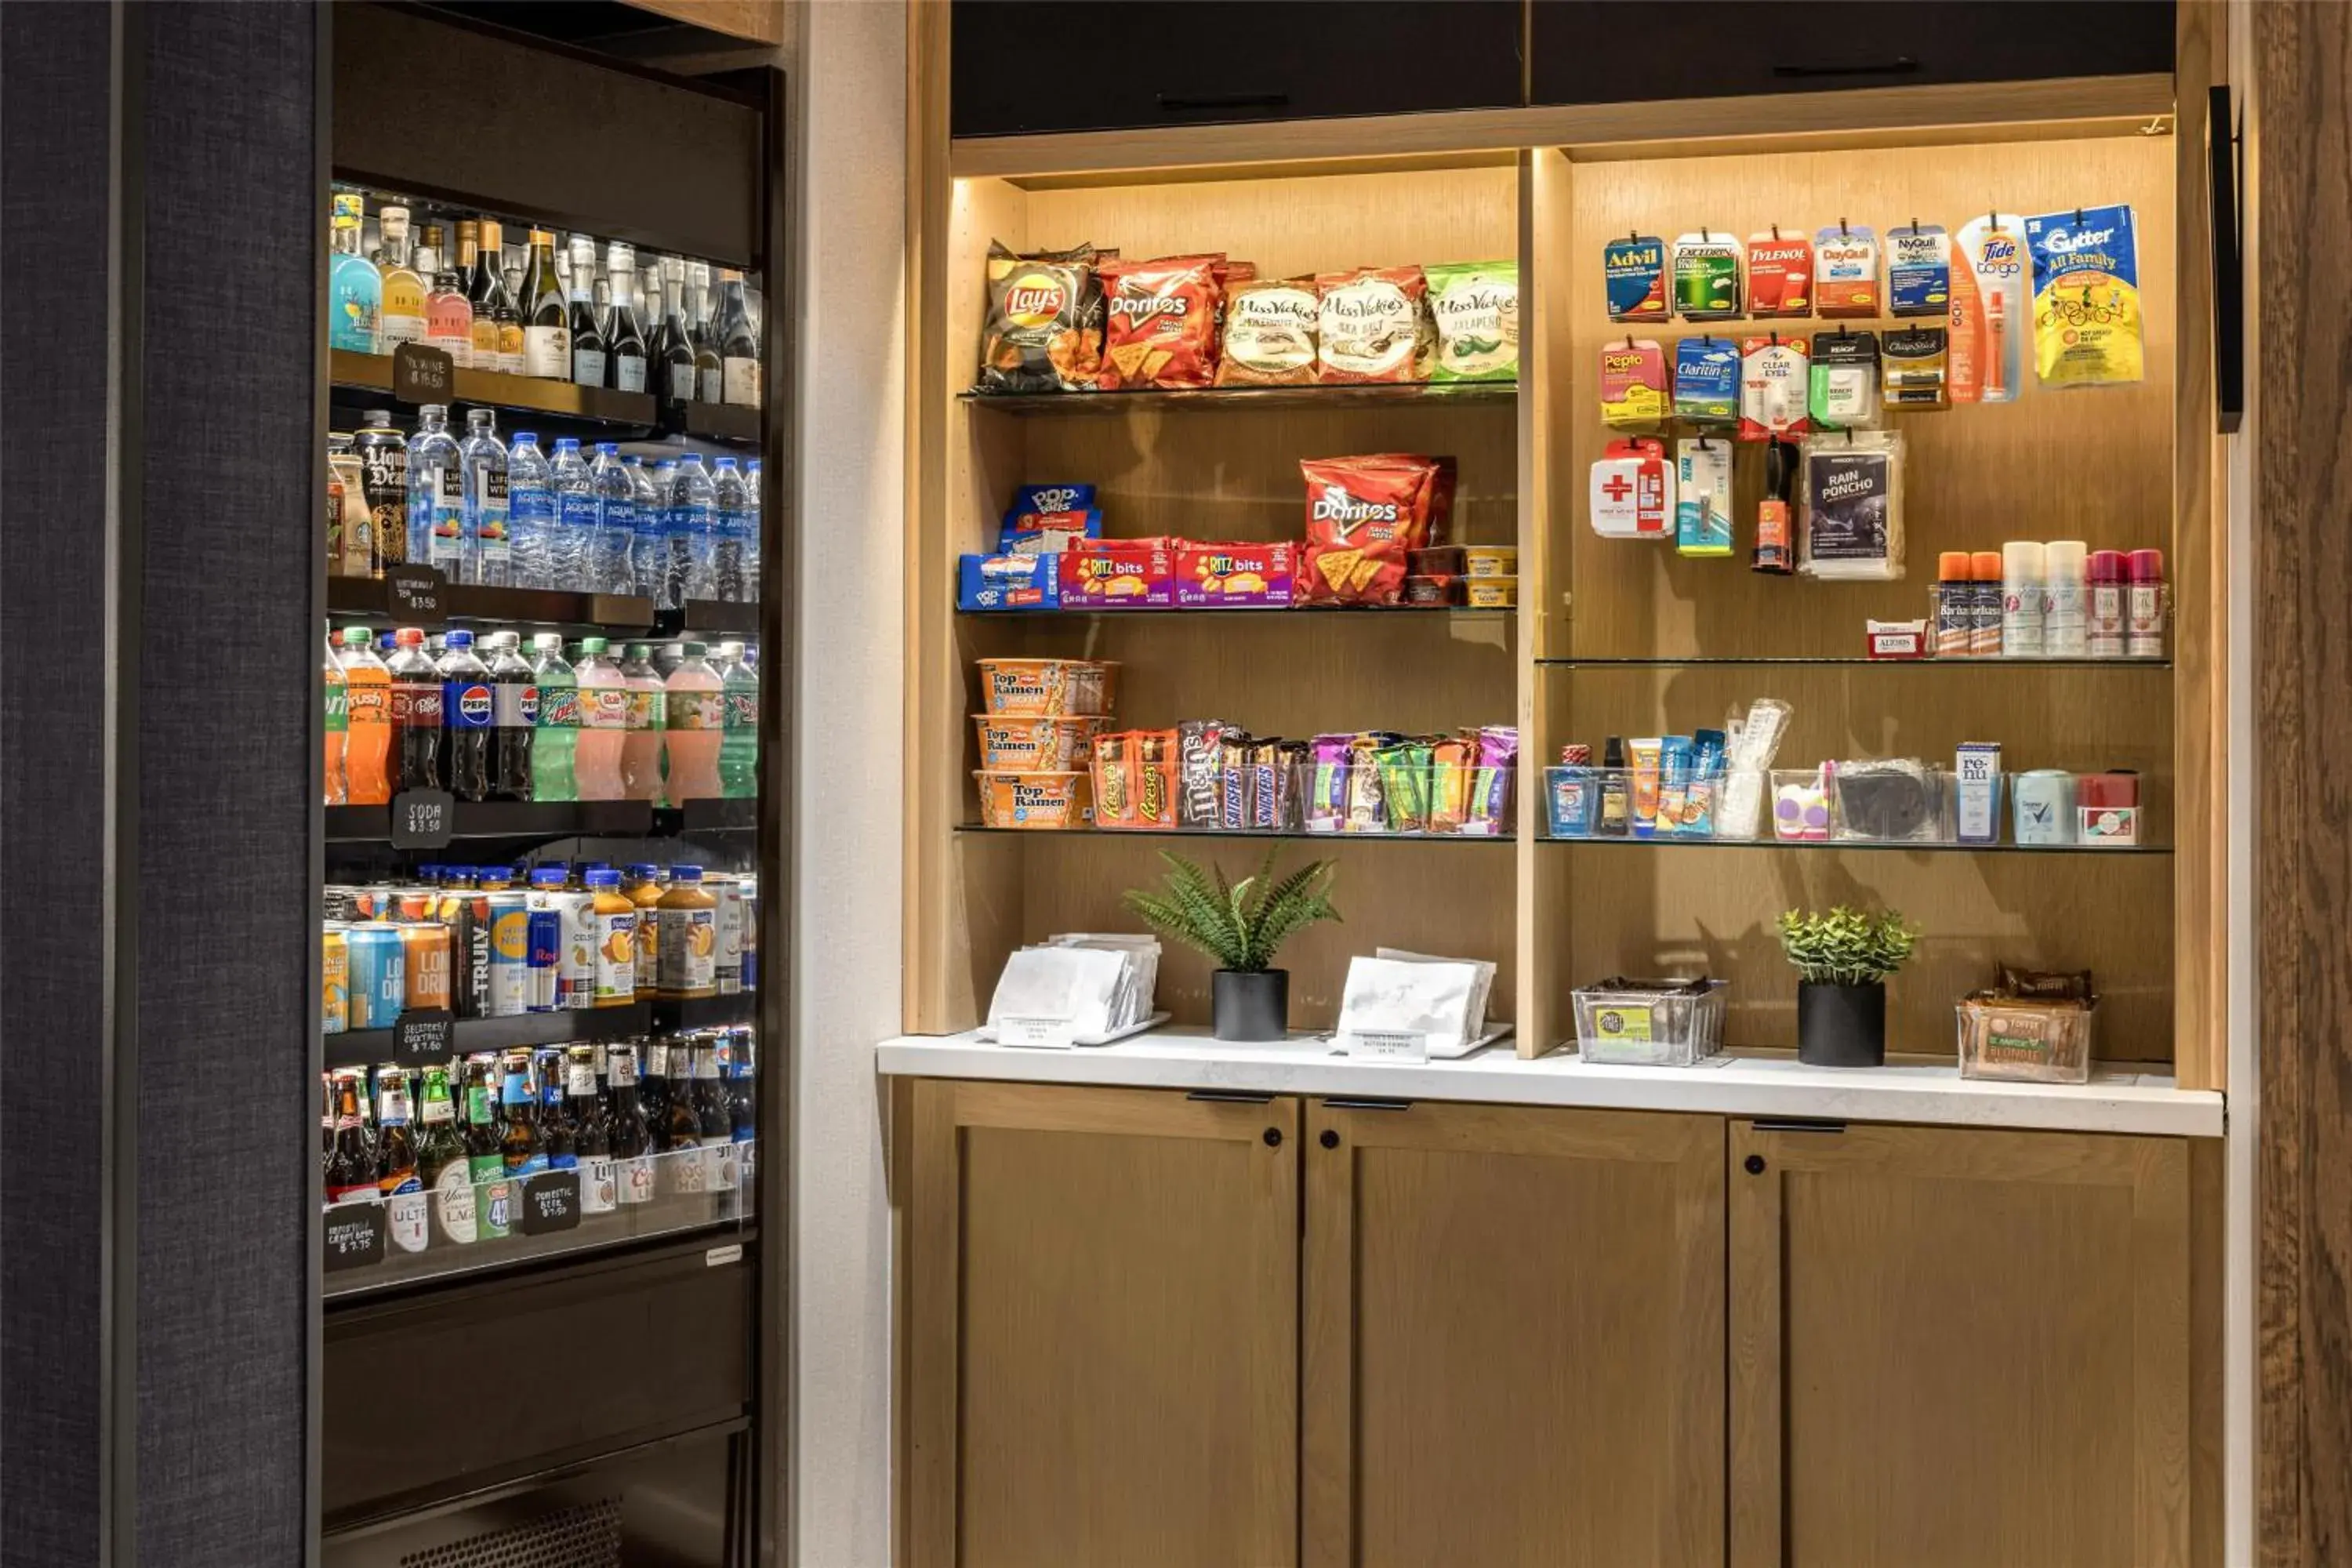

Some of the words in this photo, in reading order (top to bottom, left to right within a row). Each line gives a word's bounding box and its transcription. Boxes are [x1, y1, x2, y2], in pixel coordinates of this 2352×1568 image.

[1897, 238, 1936, 251] NyQuil
[1984, 241, 2016, 262] Tide
[1608, 249, 1657, 267] Advil
[1751, 249, 1806, 263] TYLENOL
[1823, 247, 1869, 263] DayQuil
[2049, 255, 2067, 270] All
[2068, 251, 2117, 270] Family
[1976, 262, 1996, 274] to
[2000, 263, 2020, 278] go
[1109, 297, 1188, 315] Doritos
[1322, 297, 1358, 318] Miss
[1436, 300, 1472, 314] Miss
[1605, 354, 1643, 367] Pepto
[1678, 362, 1721, 376] Claritin
[1828, 470, 1859, 486] RAIN
[1822, 477, 1874, 500] PONCHO
[1312, 500, 1397, 521] Doritos
[1090, 558, 1114, 575] RITZ
[1116, 562, 1144, 574] bits
[1209, 556, 1233, 573] RITZ
[1235, 560, 1263, 572] bits
[993, 673, 1017, 687] Top
[993, 685, 1044, 695] Ramen
[348, 690, 383, 708] rush
[463, 699, 489, 710] PEPS
[985, 729, 1009, 742] Top
[987, 741, 1036, 751] Ramen
[1012, 784, 1044, 798] Top
[1256, 766, 1274, 826] SNICKERS
[1014, 796, 1065, 808] Ramen
[408, 804, 441, 820] SODA
[473, 926, 489, 997] TRULY
[418, 974, 449, 995] DRIN
